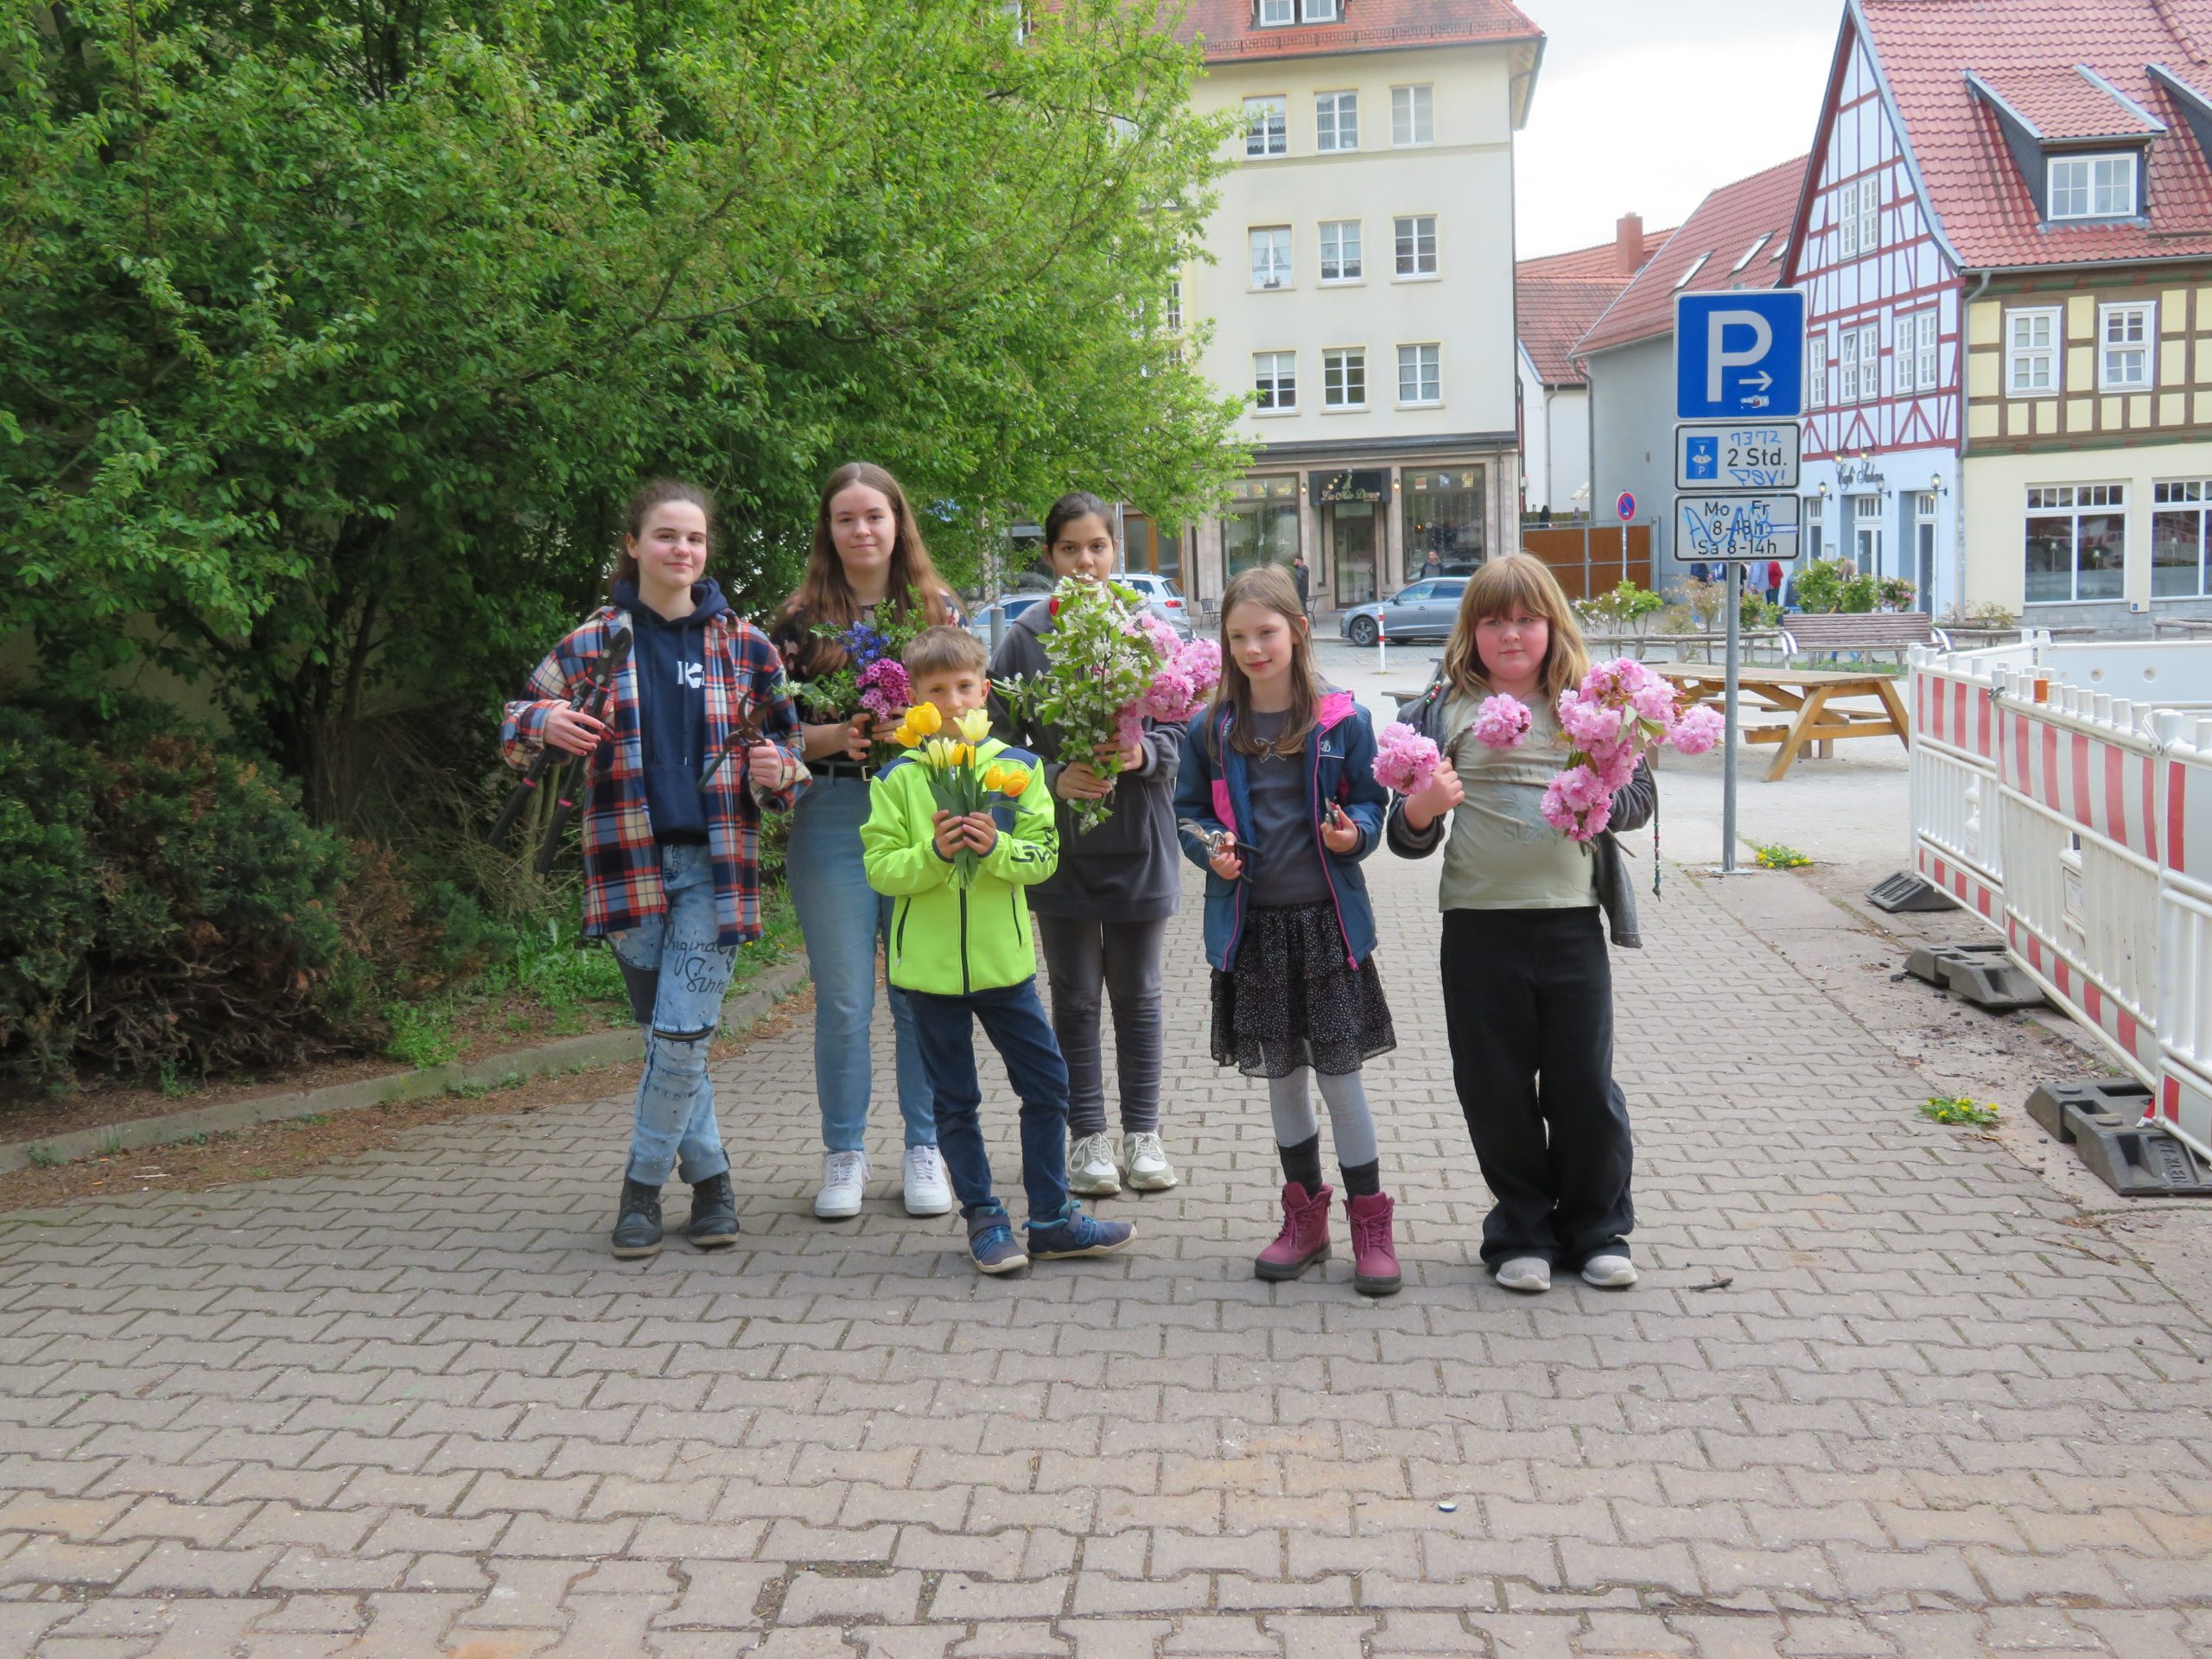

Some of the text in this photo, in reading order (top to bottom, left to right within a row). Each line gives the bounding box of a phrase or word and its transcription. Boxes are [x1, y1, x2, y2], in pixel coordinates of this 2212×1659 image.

[1707, 310, 1772, 402] P
[1727, 447, 1787, 467] 2 Std.
[1698, 466, 1706, 476] P
[1705, 500, 1770, 516] Mo Fr
[1698, 539, 1719, 555] Sa
